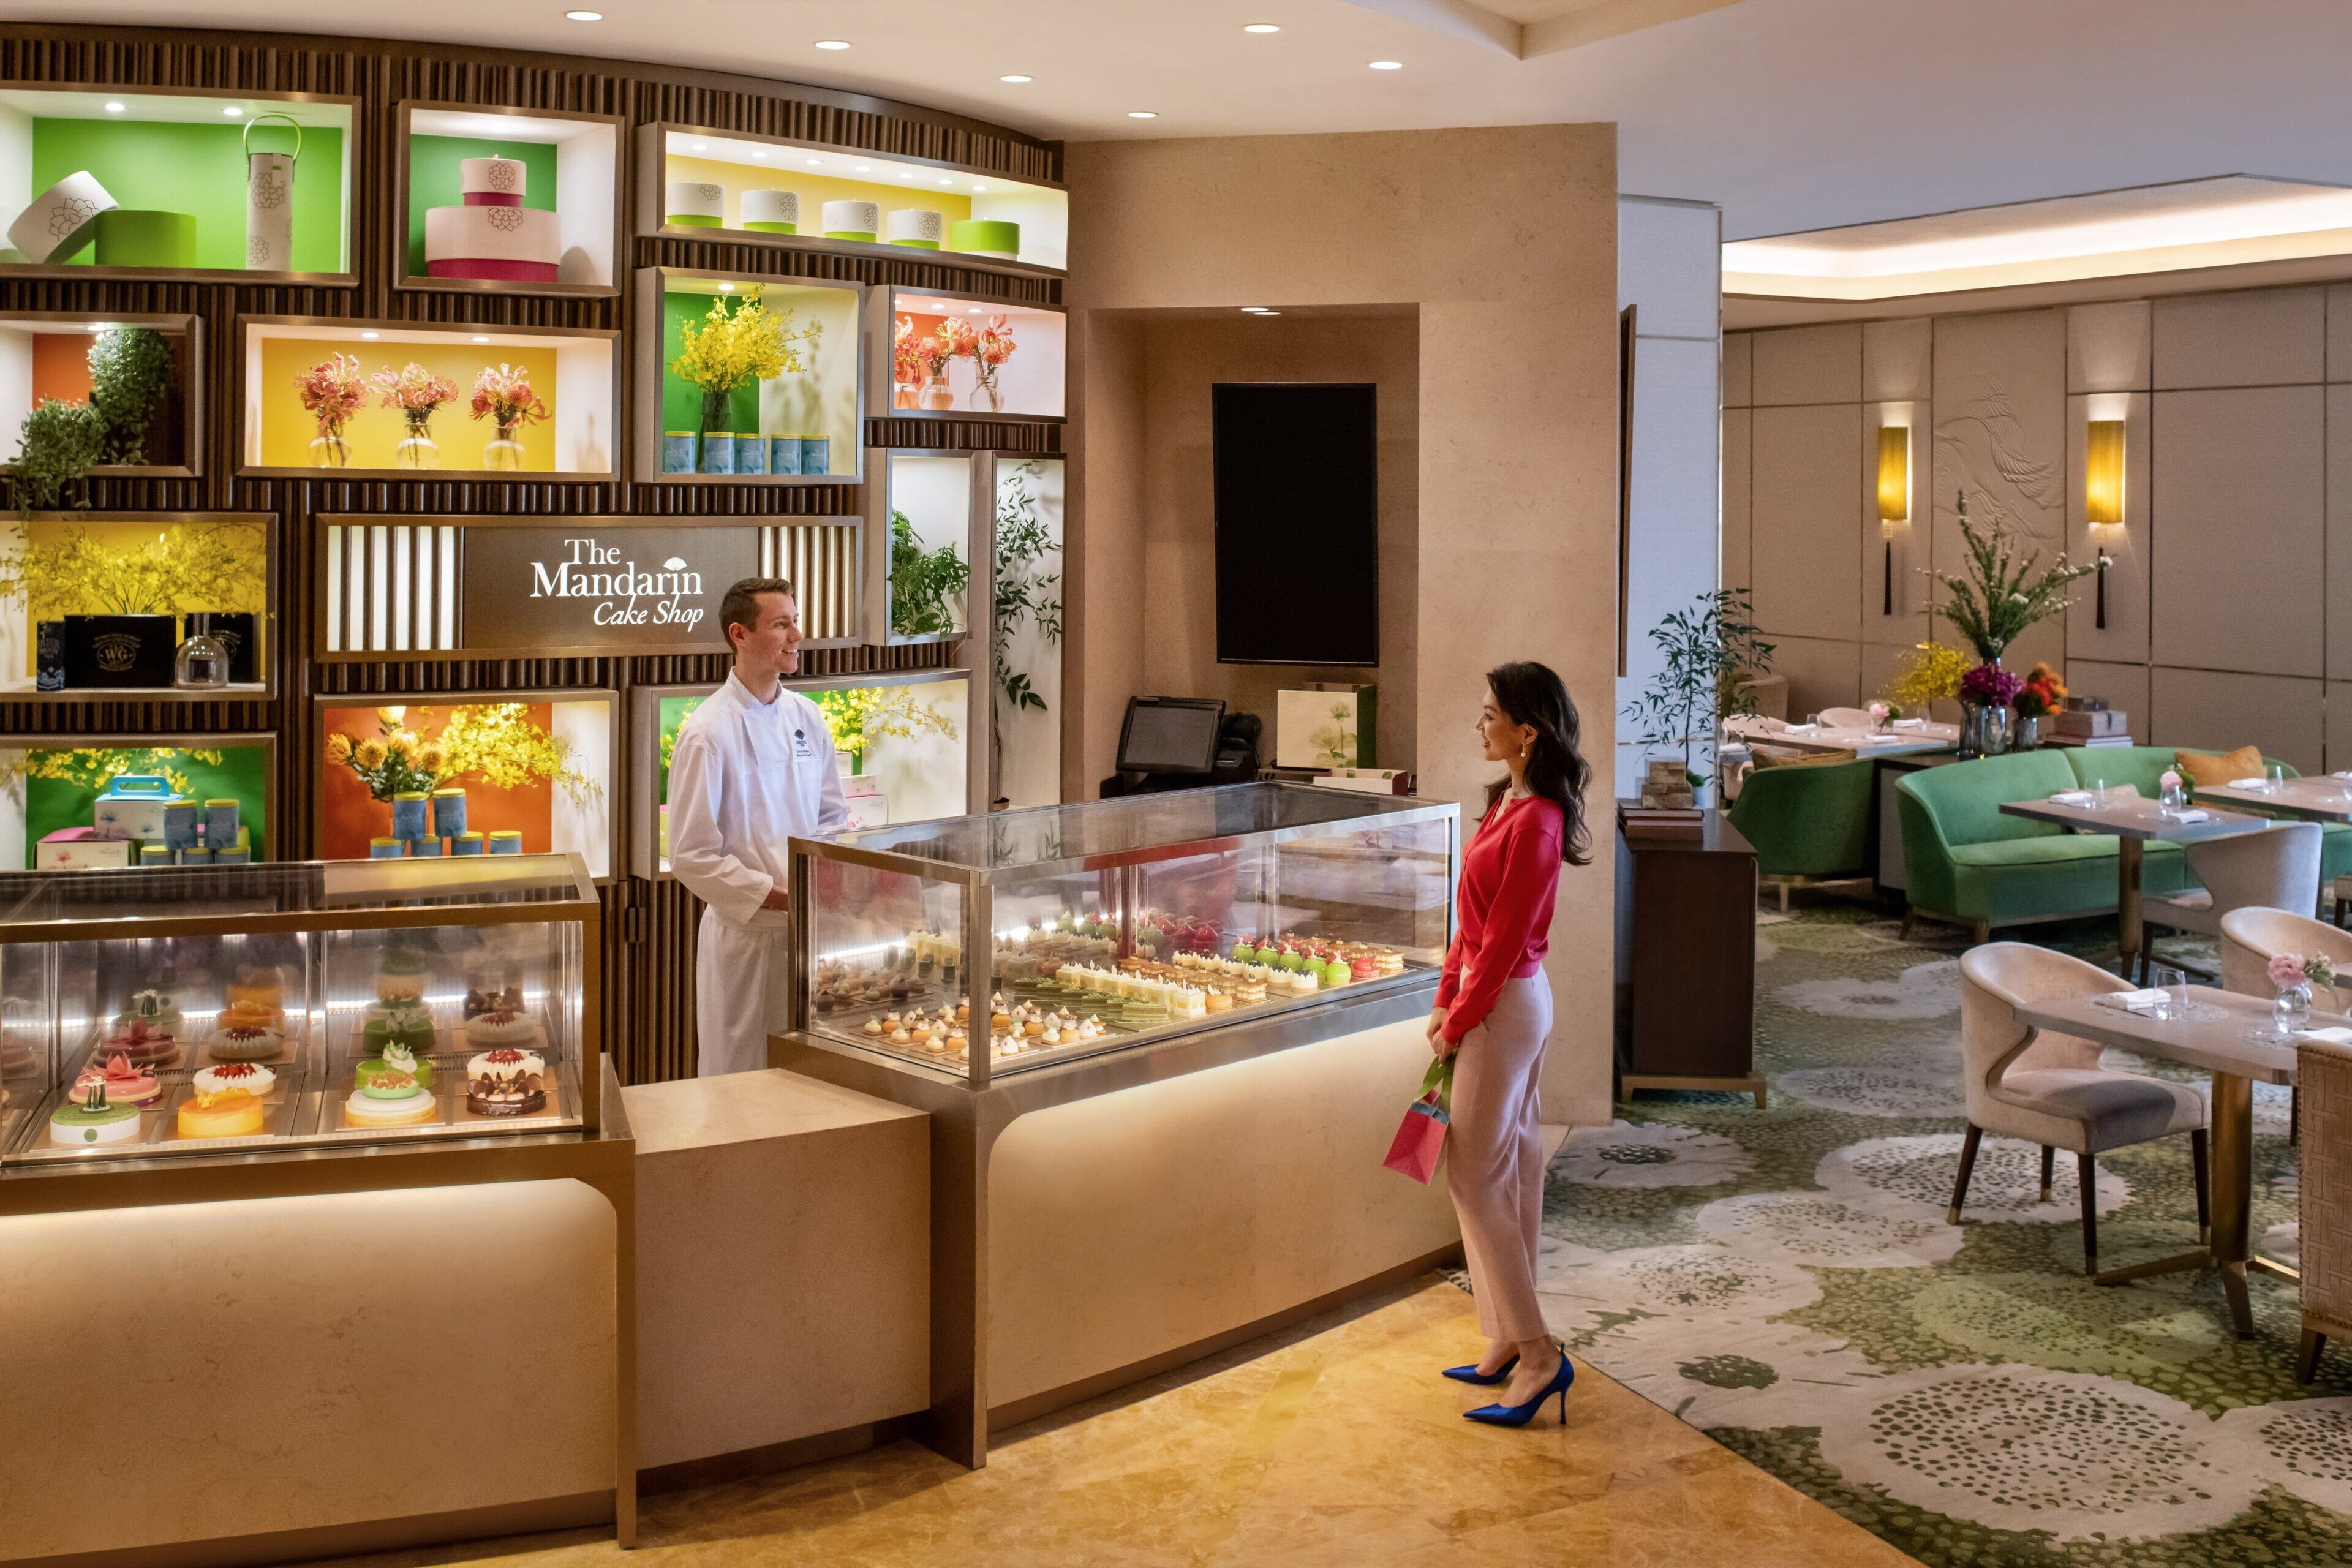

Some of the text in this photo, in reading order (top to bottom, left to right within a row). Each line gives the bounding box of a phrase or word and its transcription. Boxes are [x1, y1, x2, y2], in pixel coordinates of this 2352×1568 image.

[564, 538, 621, 565] The
[530, 560, 704, 597] Mandarin
[593, 593, 704, 633] Cake Shop
